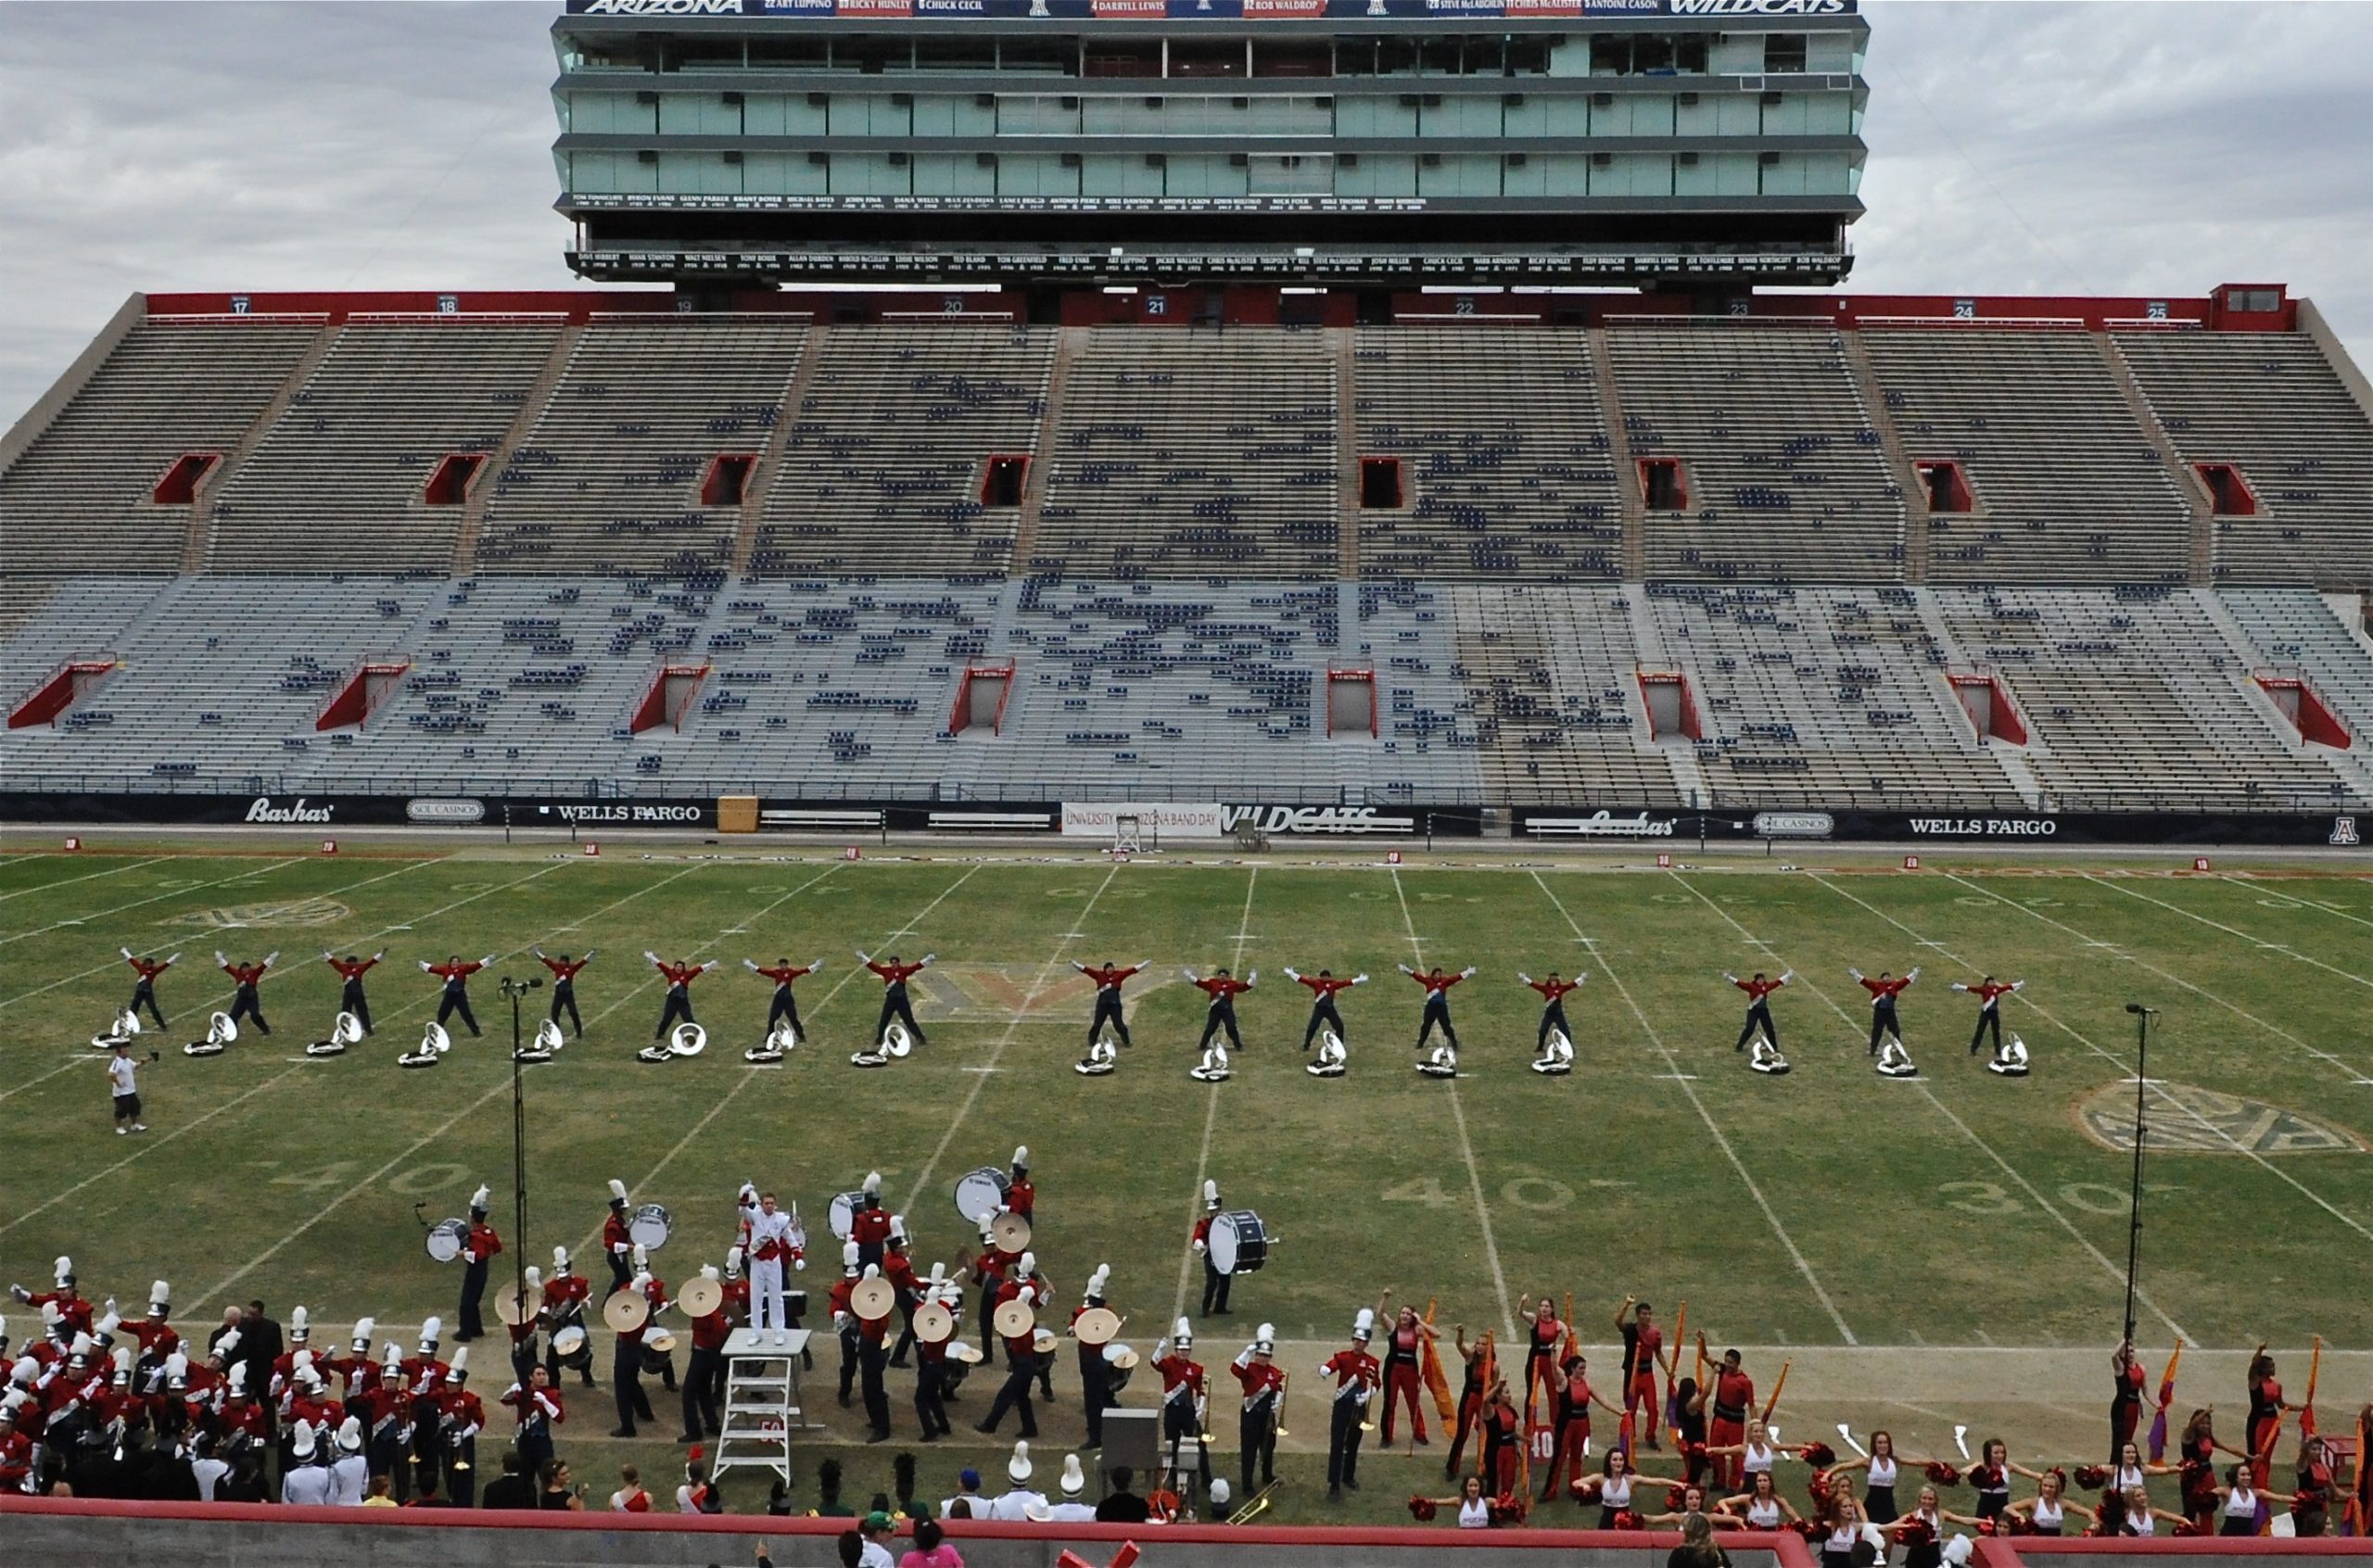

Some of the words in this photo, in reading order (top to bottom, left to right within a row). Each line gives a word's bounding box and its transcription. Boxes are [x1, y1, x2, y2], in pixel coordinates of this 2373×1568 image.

[584, 0, 743, 14] ARIZONA
[927, 1, 957, 10] CHUCK
[958, 1, 983, 10] CECIL
[1091, 0, 1098, 10] 4
[1099, 2, 1137, 10] DARRYLL
[1139, 2, 1165, 10] LEWIS
[1256, 1, 1275, 9] ROB
[1276, 1, 1317, 9] WALDROP
[1592, 0, 1627, 8] ANTOINE
[1629, 0, 1657, 8] CASON
[1670, 0, 1845, 14] WILDCATS
[235, 302, 247, 314] 17
[440, 301, 455, 313] 18
[678, 301, 692, 312] 19
[945, 300, 962, 312] 20
[1148, 301, 1164, 313] 21
[1456, 302, 1473, 314] 22
[1731, 304, 1747, 316] 23
[1955, 306, 1973, 317] 24
[2148, 308, 2165, 319] 25
[246, 797, 334, 822] Bashas'
[435, 805, 476, 814] CASINOS
[558, 806, 628, 819] WELLS
[632, 807, 701, 820] FARGO
[1066, 812, 1112, 825] UNIVERSITY
[1172, 814, 1196, 826] BAND
[1199, 814, 1216, 826] DAY
[1782, 819, 1825, 828] CASINOS
[1910, 820, 1982, 833] WELLS
[1986, 820, 2055, 834] FARGO
[1381, 1178, 1576, 1210] 40
[1938, 1182, 2134, 1215] 30
